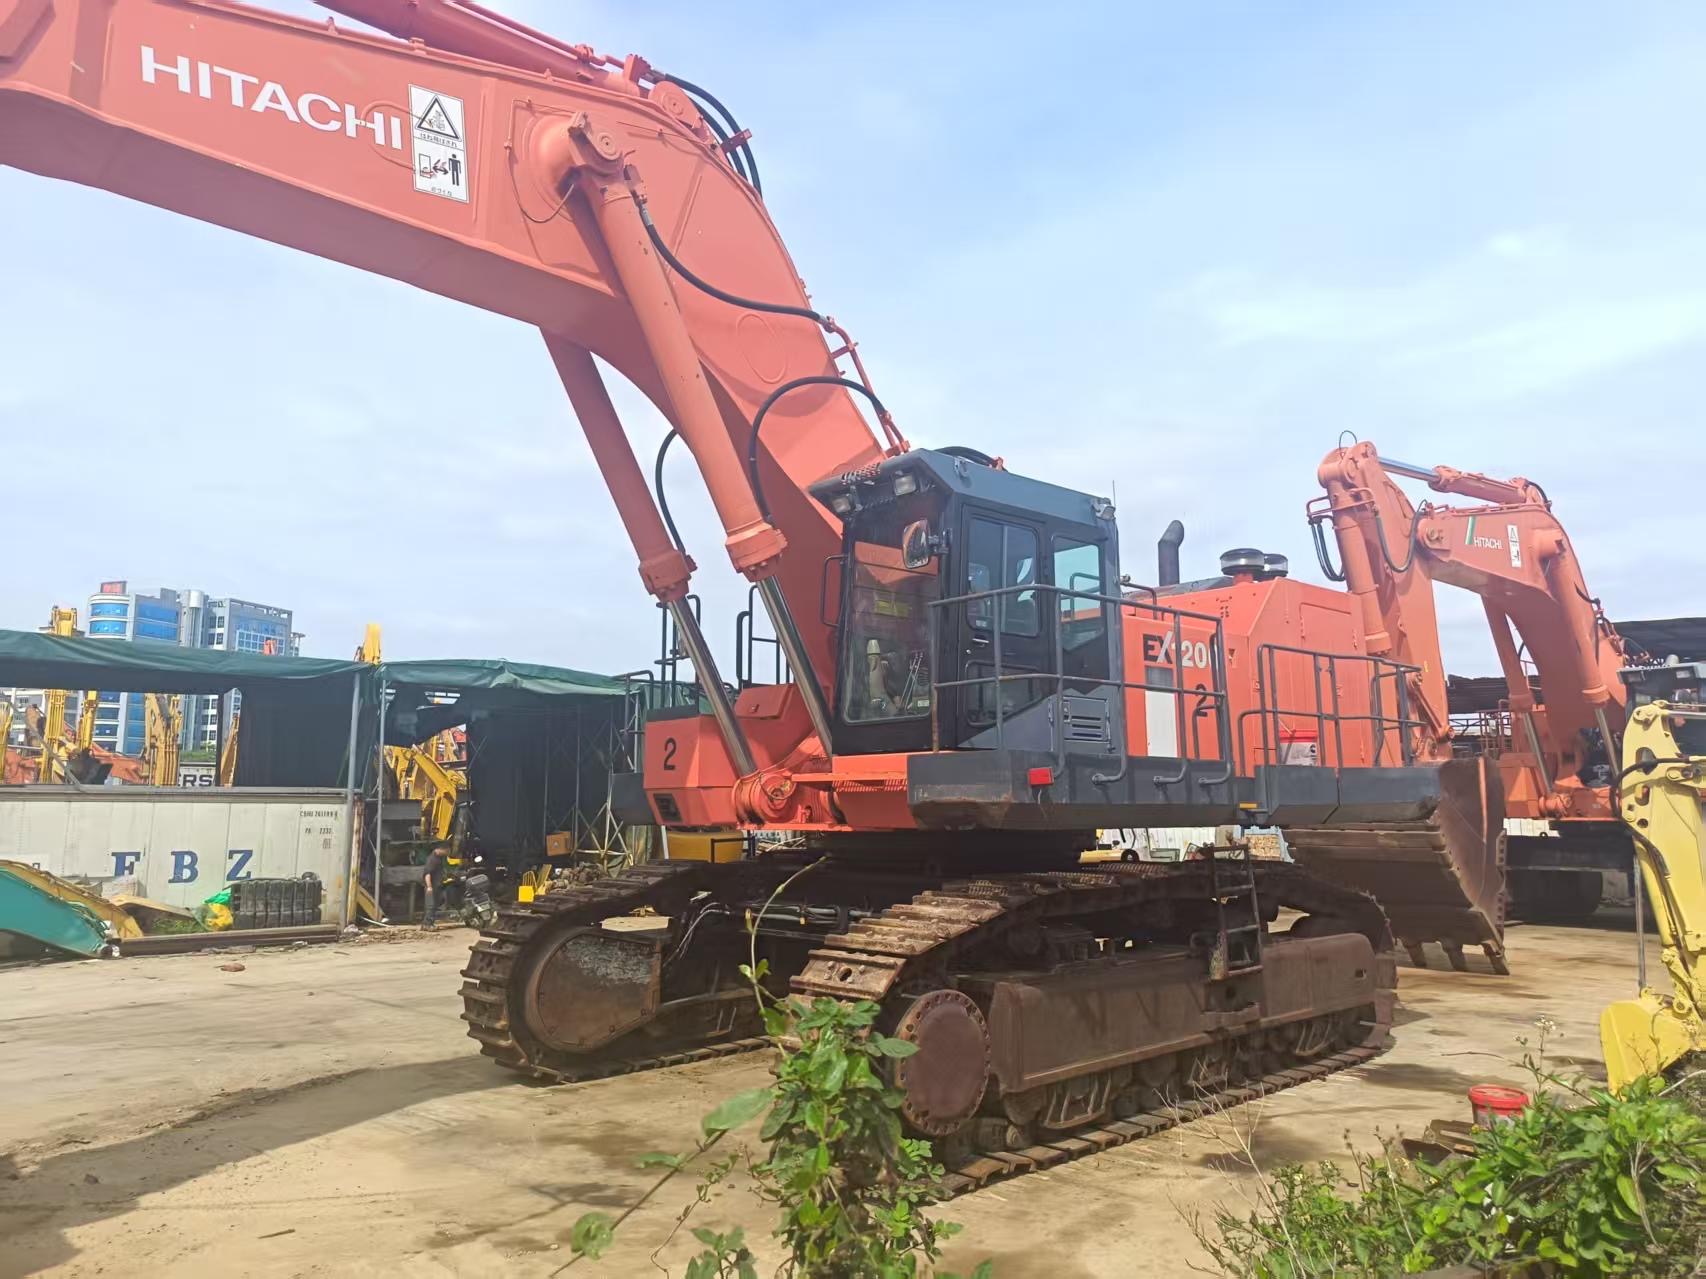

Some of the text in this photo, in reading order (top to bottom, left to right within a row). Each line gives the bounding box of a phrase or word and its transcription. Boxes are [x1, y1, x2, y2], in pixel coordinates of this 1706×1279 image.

[140, 45, 403, 150] HITACHI
[1473, 536, 1502, 549] HITACHI
[1195, 683, 1208, 717] 2
[664, 738, 677, 771] 2
